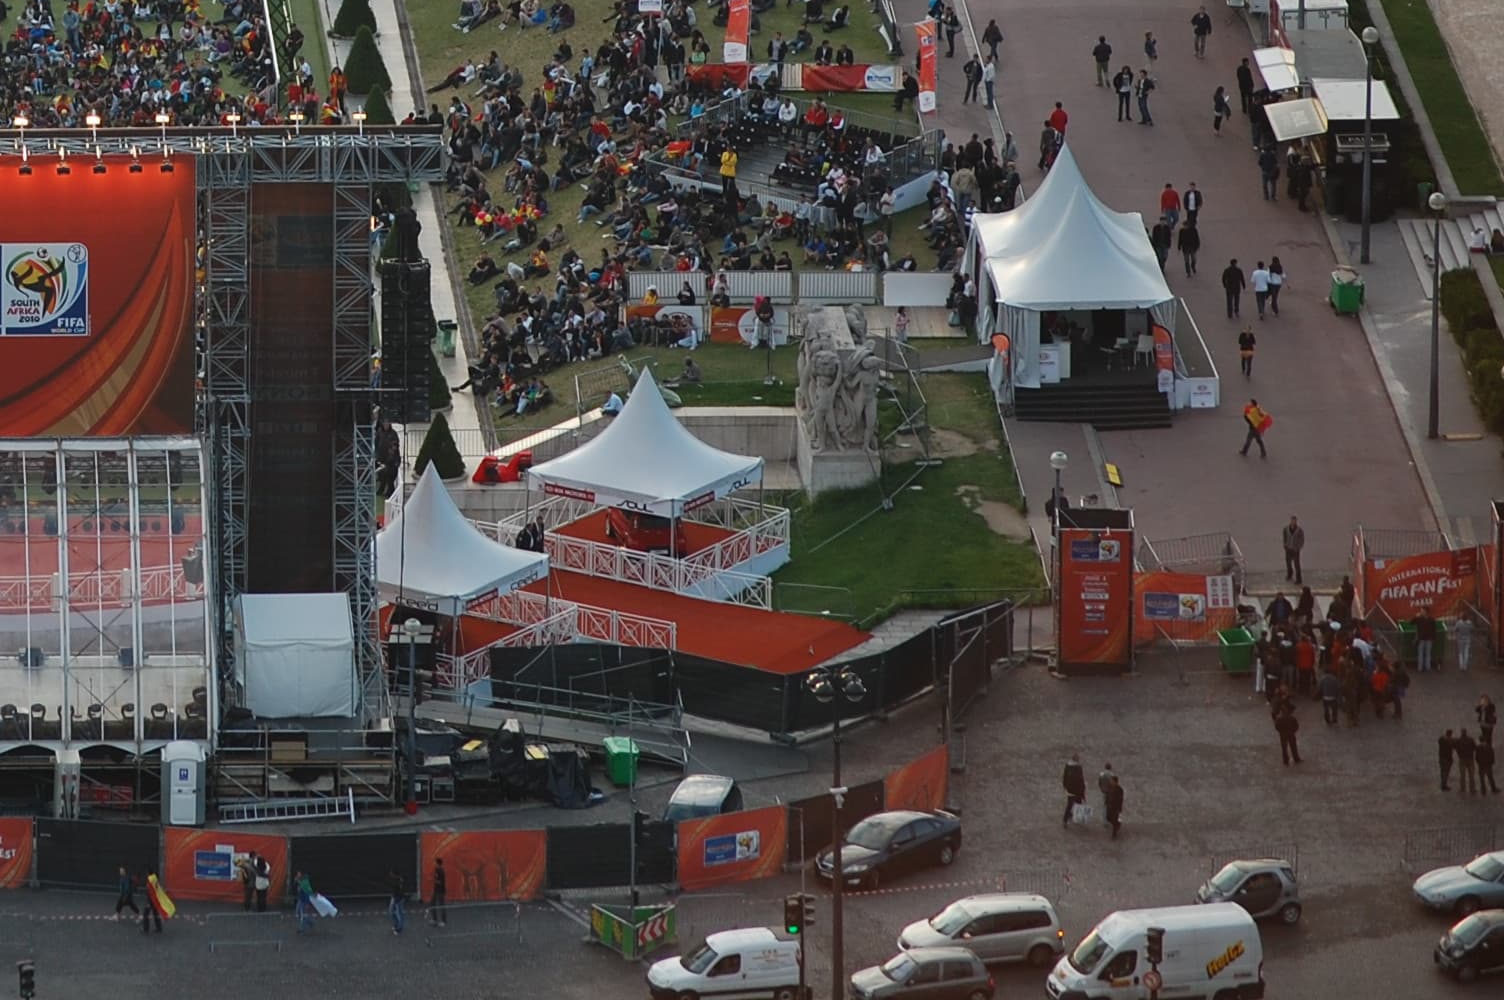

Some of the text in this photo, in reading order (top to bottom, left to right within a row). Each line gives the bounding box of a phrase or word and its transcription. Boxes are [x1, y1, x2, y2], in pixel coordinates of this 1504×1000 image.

[7, 307, 41, 315] AFRICA
[57, 317, 85, 328] FIFA
[1381, 585, 1408, 600] FIFA
[1410, 580, 1436, 598] FAN
[1206, 940, 1245, 979] Hertz
